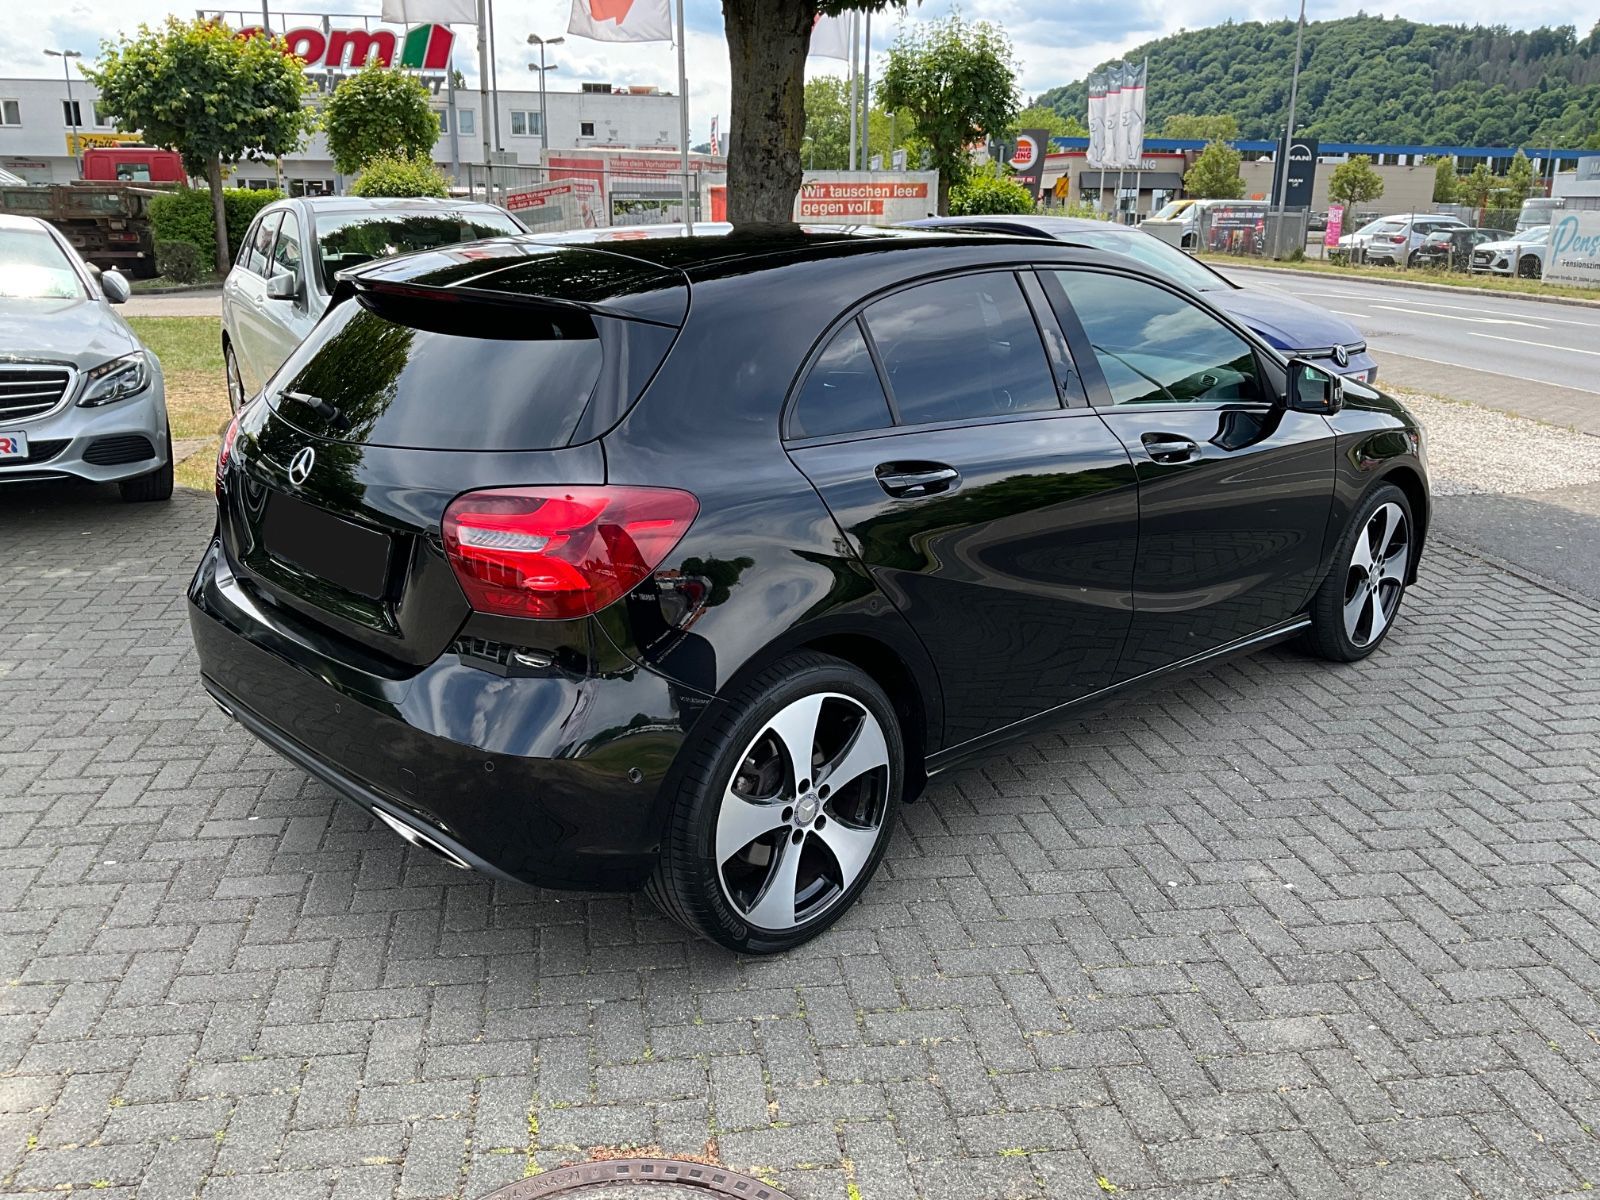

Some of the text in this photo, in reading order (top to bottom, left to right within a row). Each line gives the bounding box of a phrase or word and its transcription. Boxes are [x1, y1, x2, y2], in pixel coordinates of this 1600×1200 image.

[803, 184, 919, 198] Wir tauschen leer
[802, 201, 875, 216] gegen voll.
